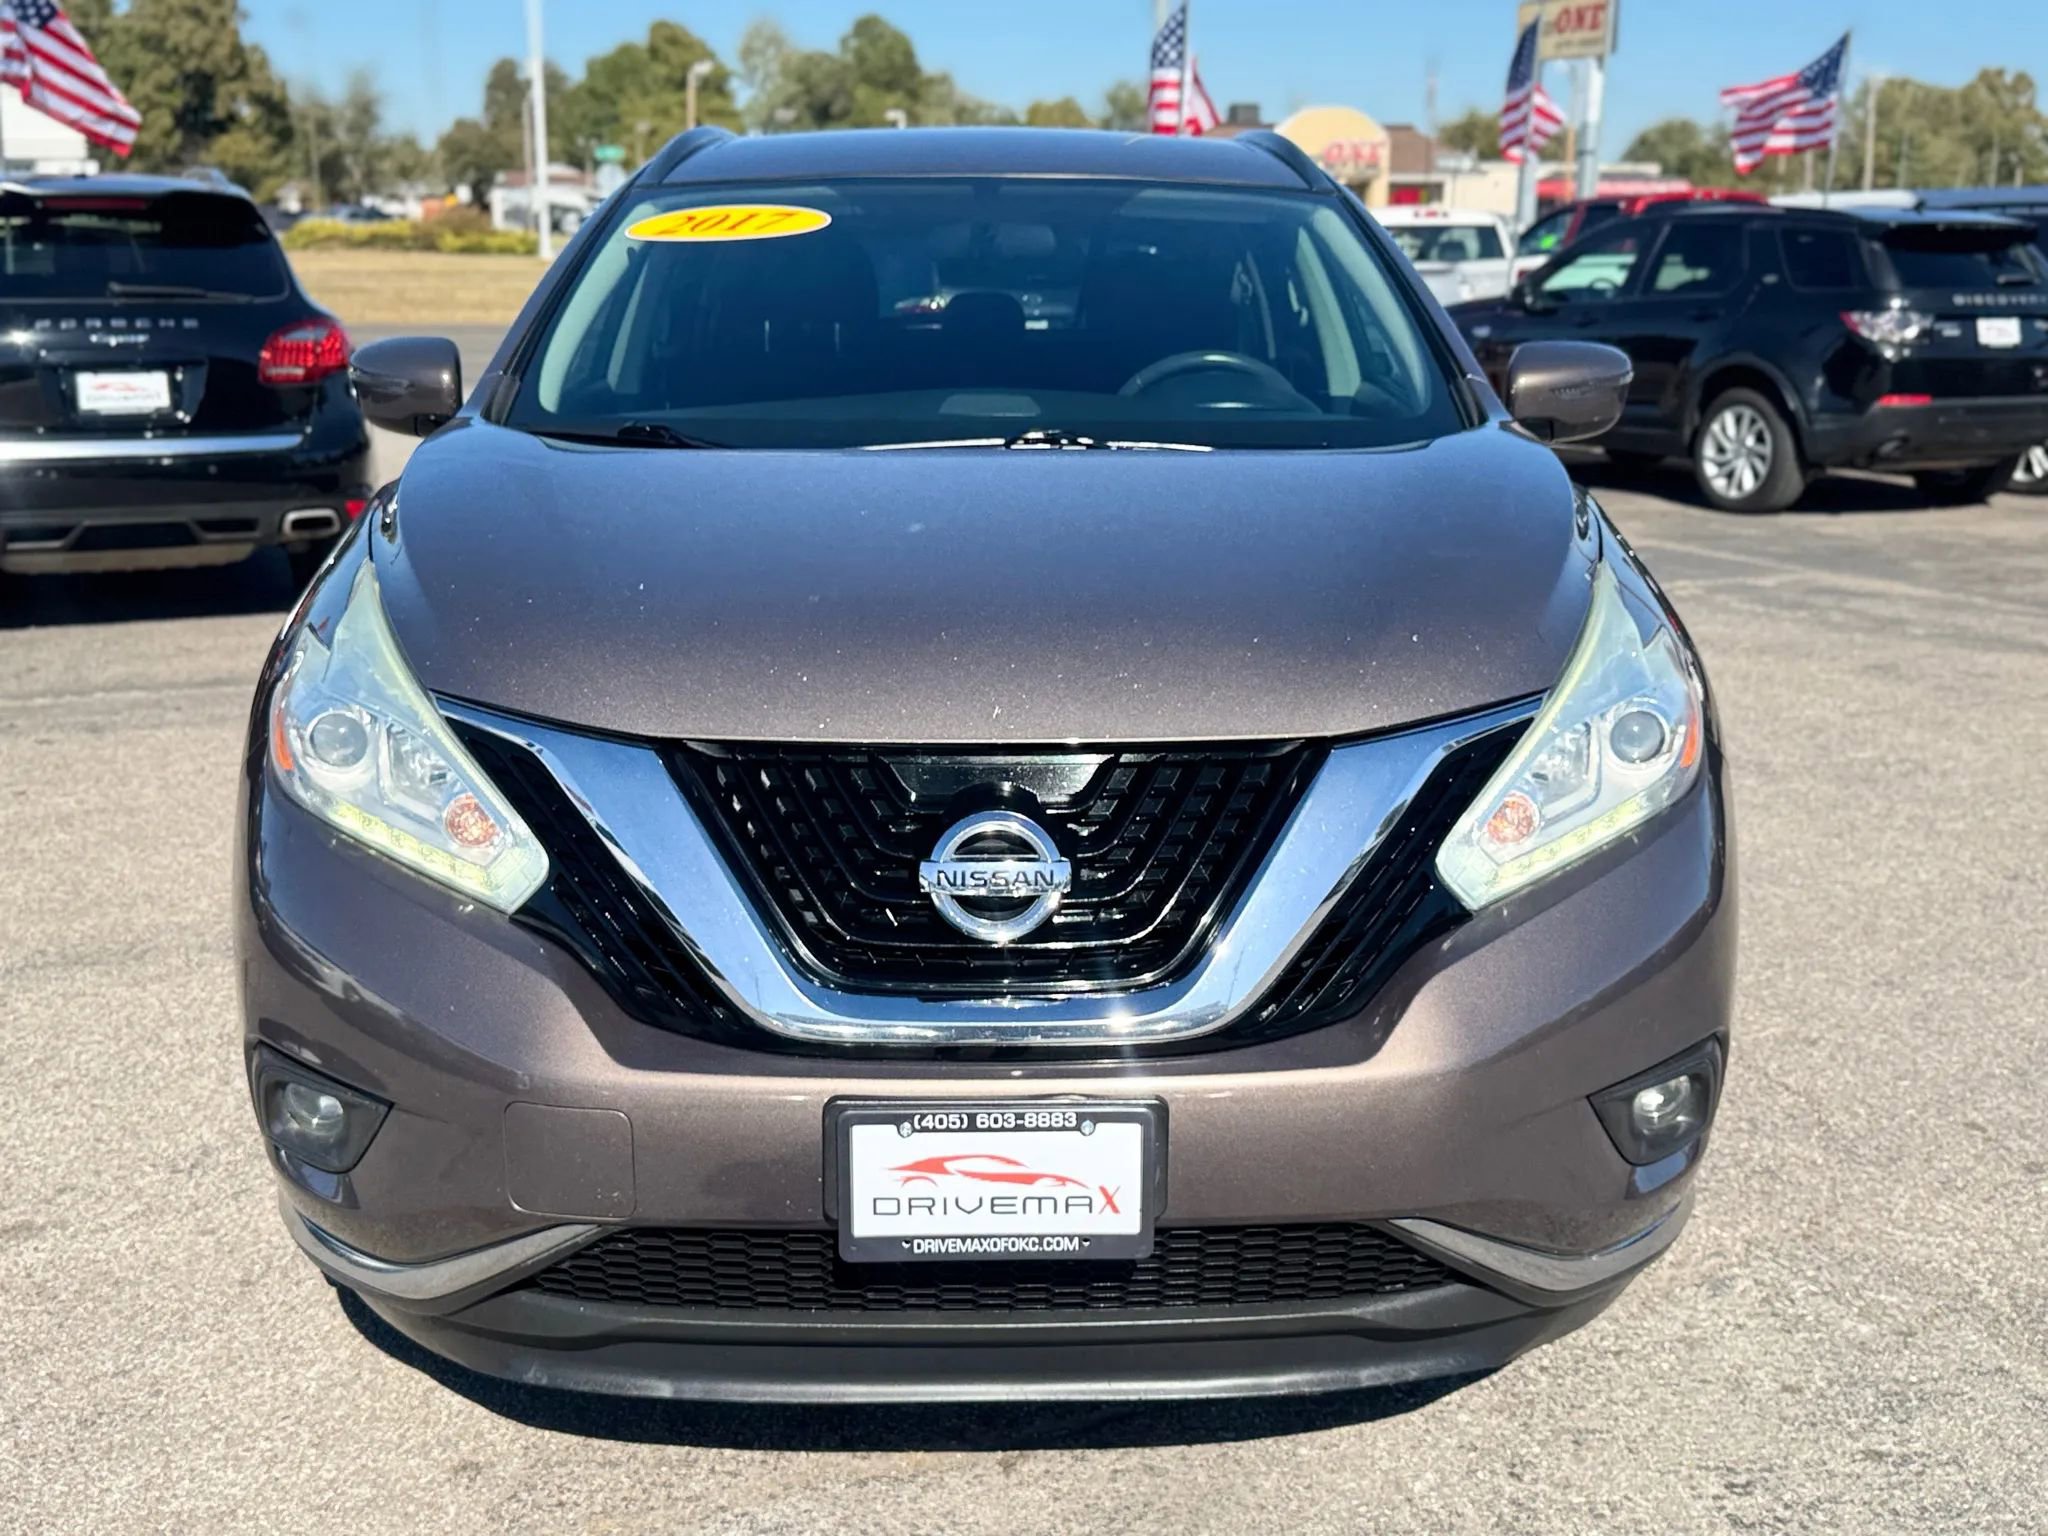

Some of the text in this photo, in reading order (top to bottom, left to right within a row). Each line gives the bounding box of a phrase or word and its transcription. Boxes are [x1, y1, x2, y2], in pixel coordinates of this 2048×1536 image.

[1553, 5, 1606, 33] ONE
[654, 212, 801, 235] 2017
[936, 869, 1055, 888] NISSAN
[913, 1112, 1077, 1130] (405) 603-8883
[872, 1184, 1122, 1216] DRIVEMAX
[912, 1237, 1080, 1254] DRIVEMAXOFOKC.COM
